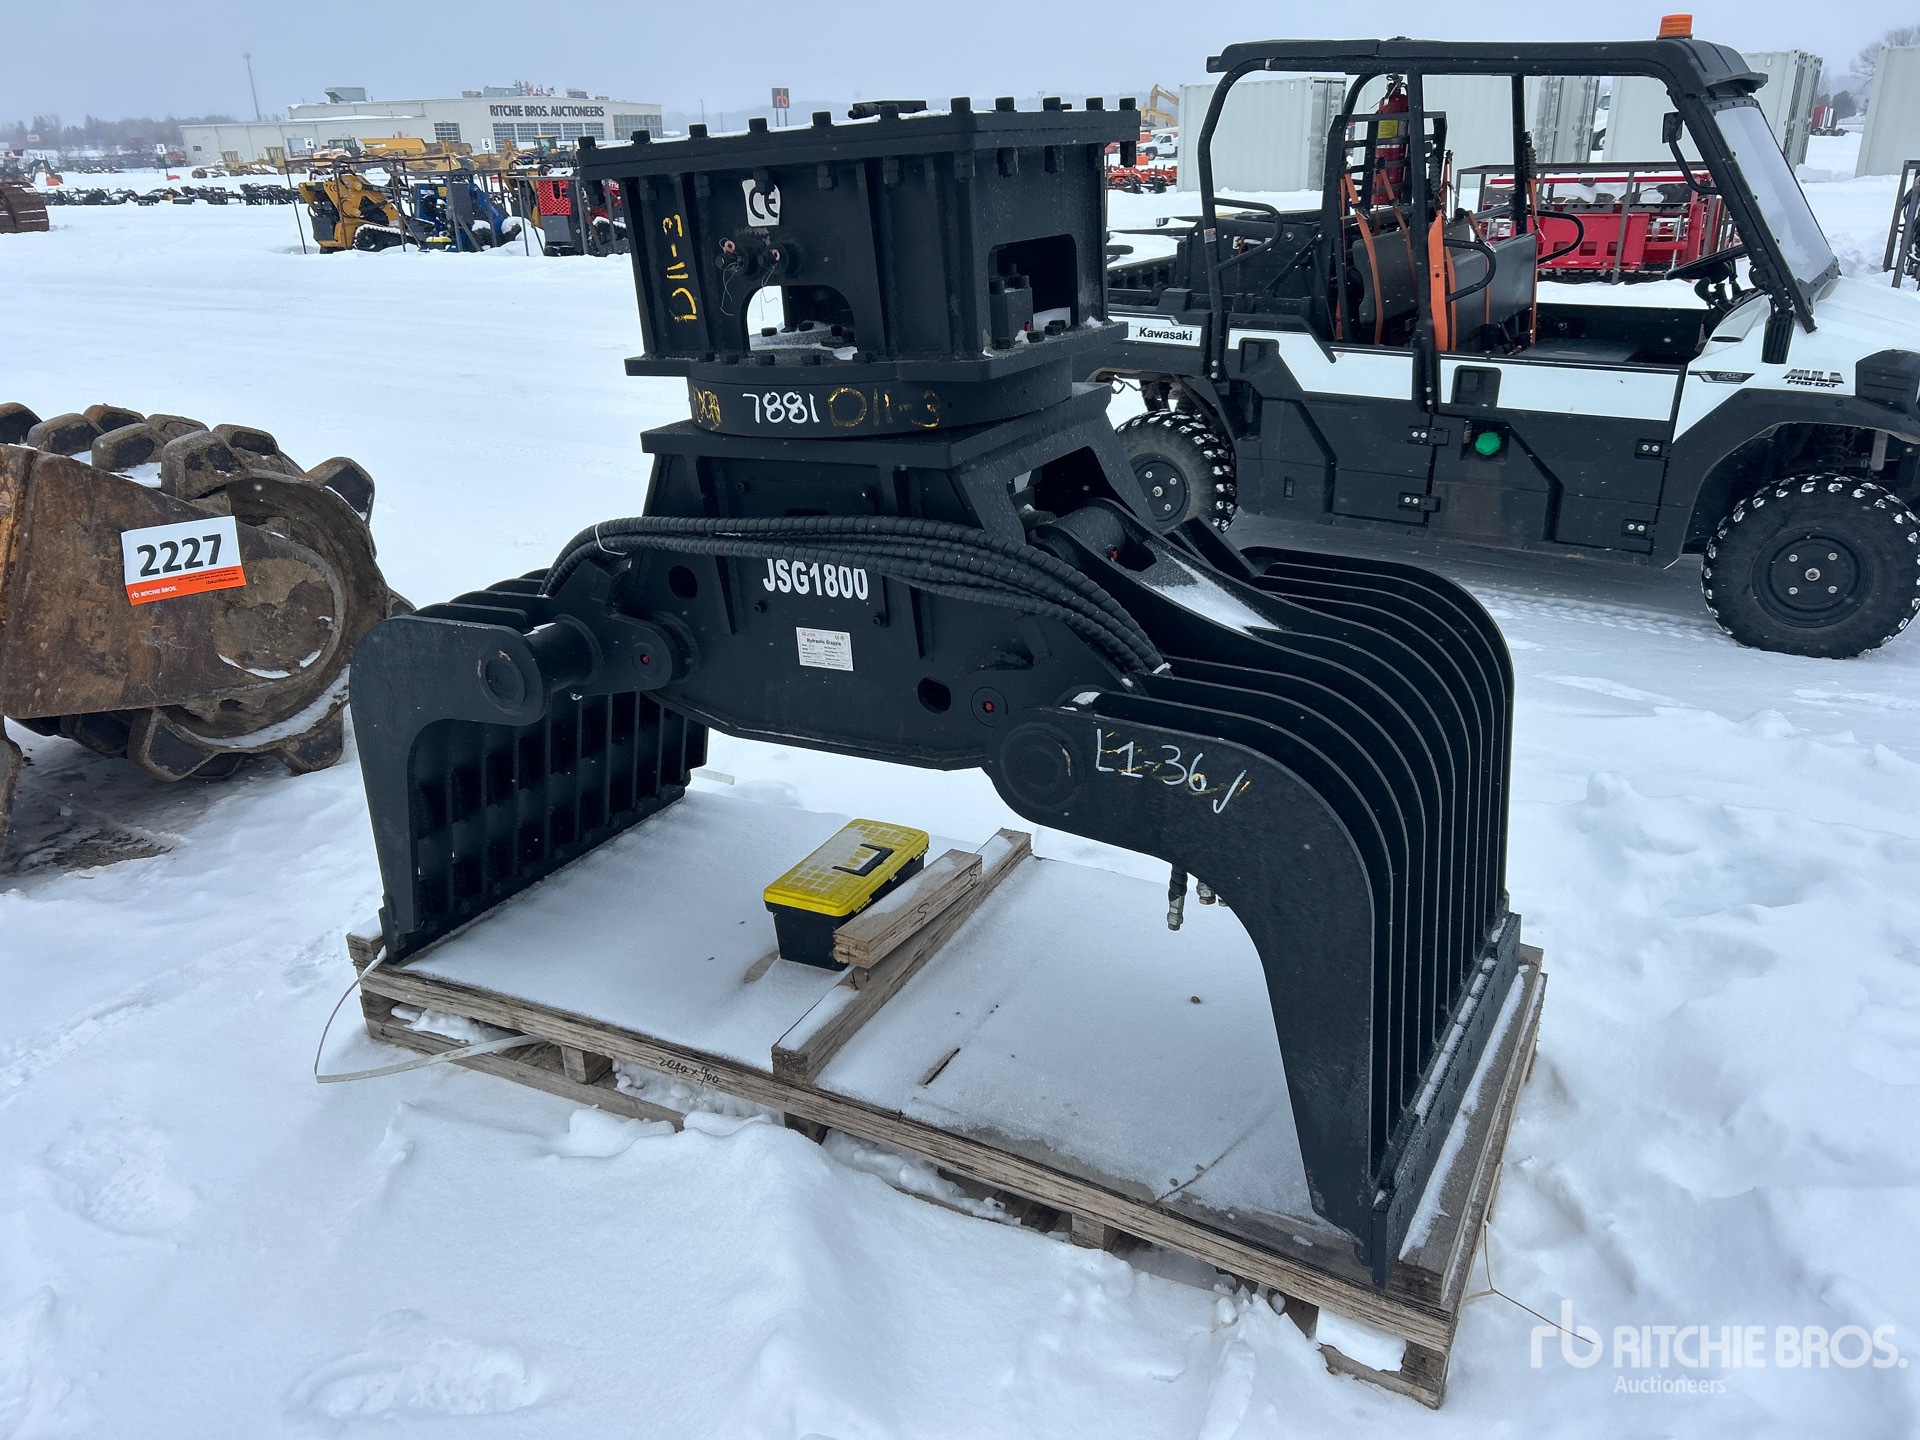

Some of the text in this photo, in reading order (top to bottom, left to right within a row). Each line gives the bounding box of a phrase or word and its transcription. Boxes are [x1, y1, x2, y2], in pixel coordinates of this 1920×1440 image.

[489, 105, 605, 117] RITCHIE BROS. AUCTIONEERS
[484, 141, 489, 149] 5
[1139, 326, 1193, 341] Kawasaki
[1786, 379, 1839, 388] PRO-DXT
[742, 391, 820, 424] 7881
[136, 533, 222, 577] 2227
[762, 558, 869, 600] JSG1800
[140, 587, 161, 597] RITCHIE
